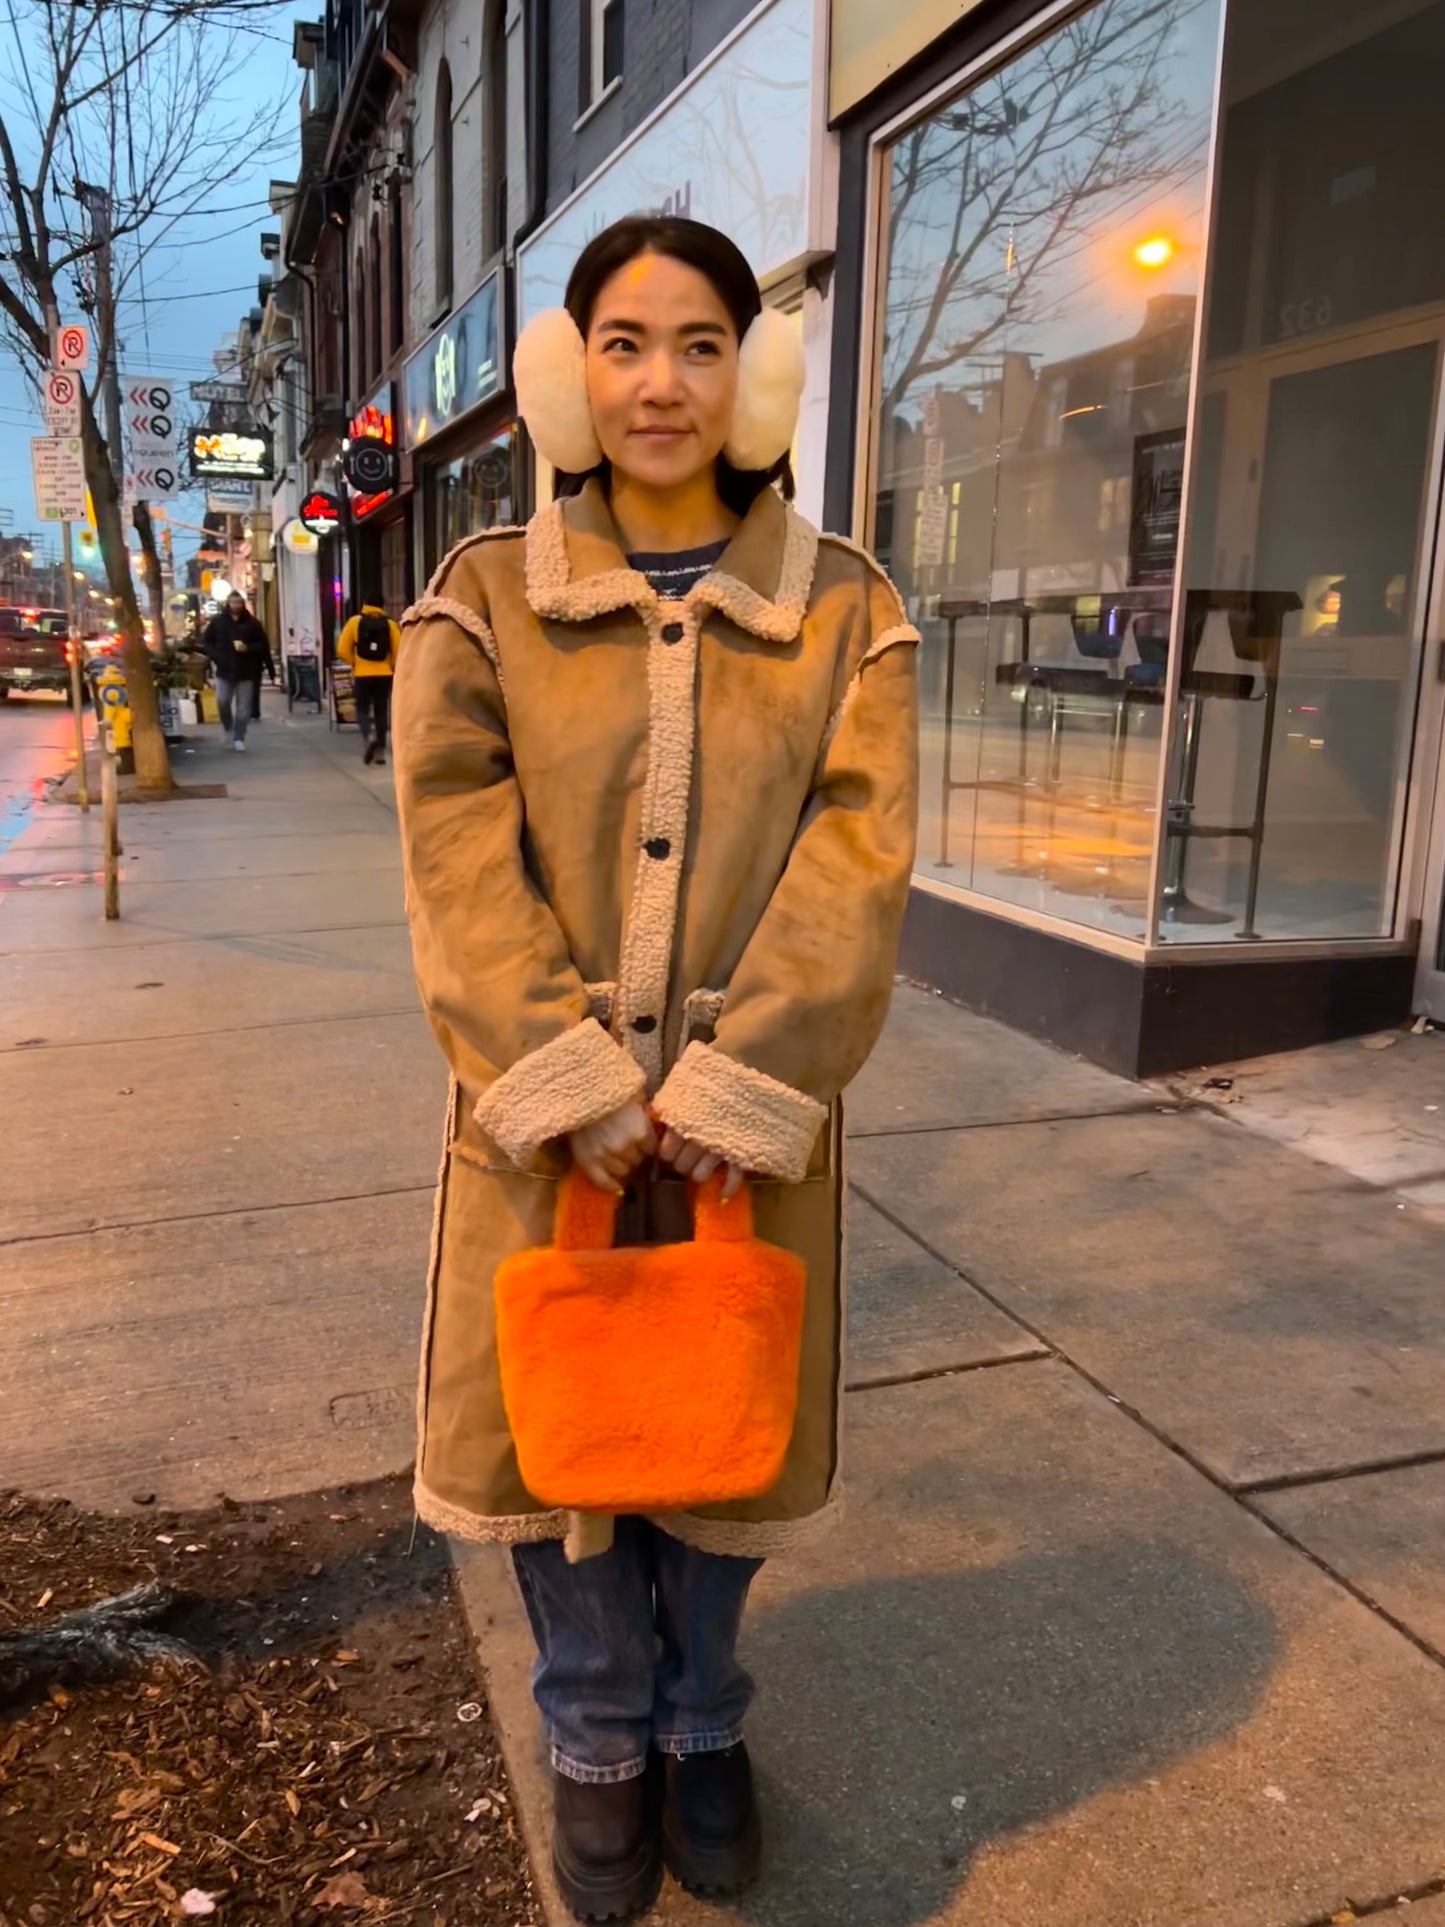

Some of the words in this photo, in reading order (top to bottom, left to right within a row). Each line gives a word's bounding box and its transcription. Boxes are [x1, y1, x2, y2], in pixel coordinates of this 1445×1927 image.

[149, 387, 171, 412] Q
[150, 415, 172, 440] Q
[155, 468, 175, 492] Q
